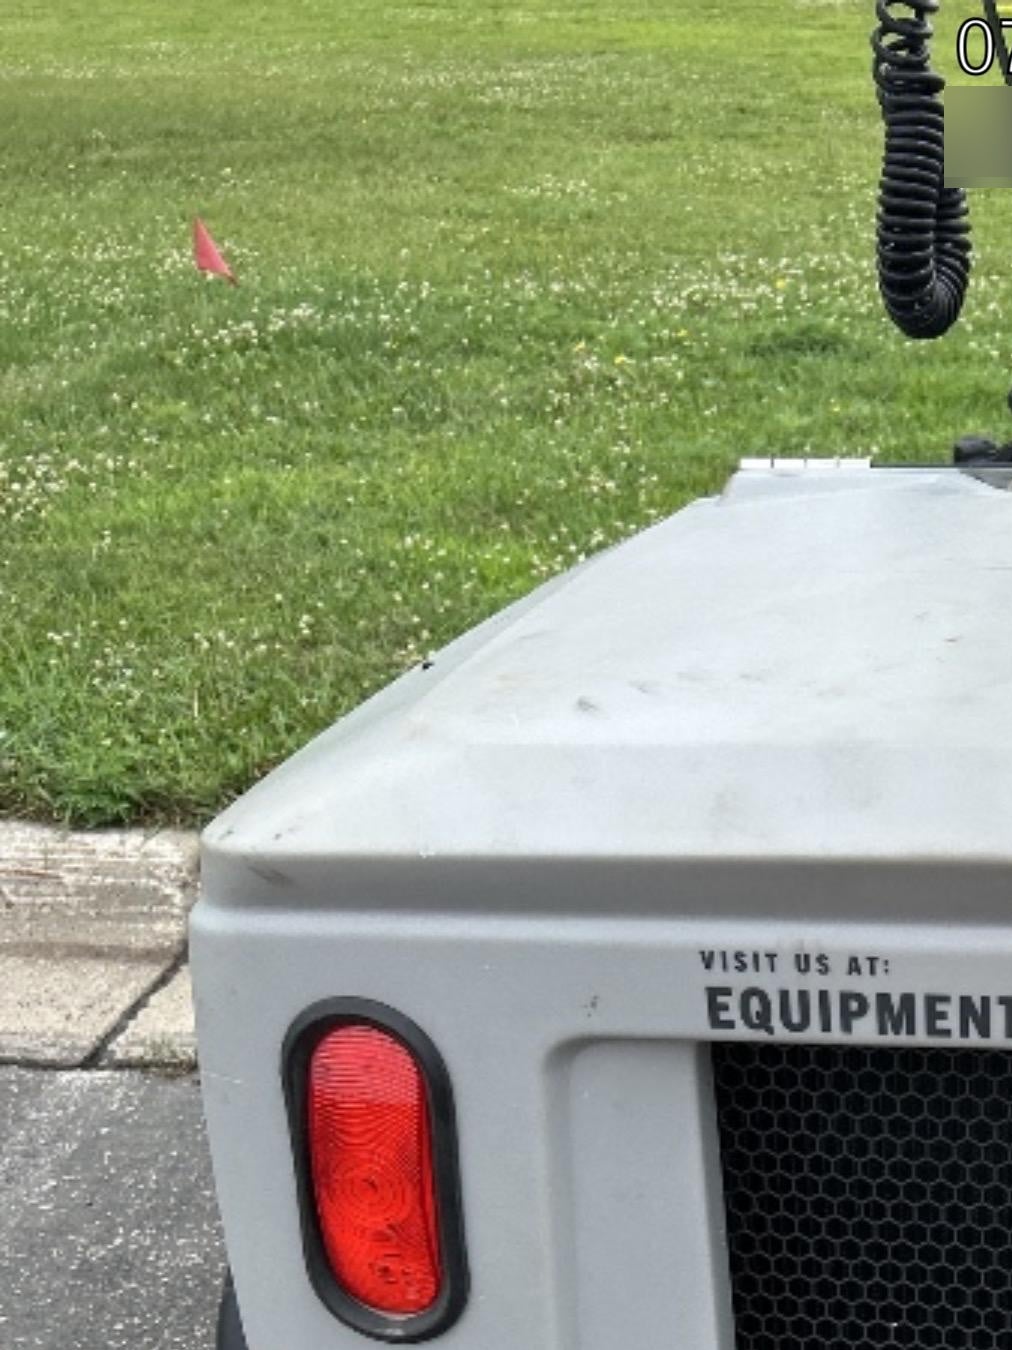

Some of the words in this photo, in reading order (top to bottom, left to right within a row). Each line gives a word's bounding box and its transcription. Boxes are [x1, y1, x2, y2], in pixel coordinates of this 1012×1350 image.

[699, 949, 779, 974] VISIT
[794, 952, 831, 976] US
[846, 955, 890, 977] AT:
